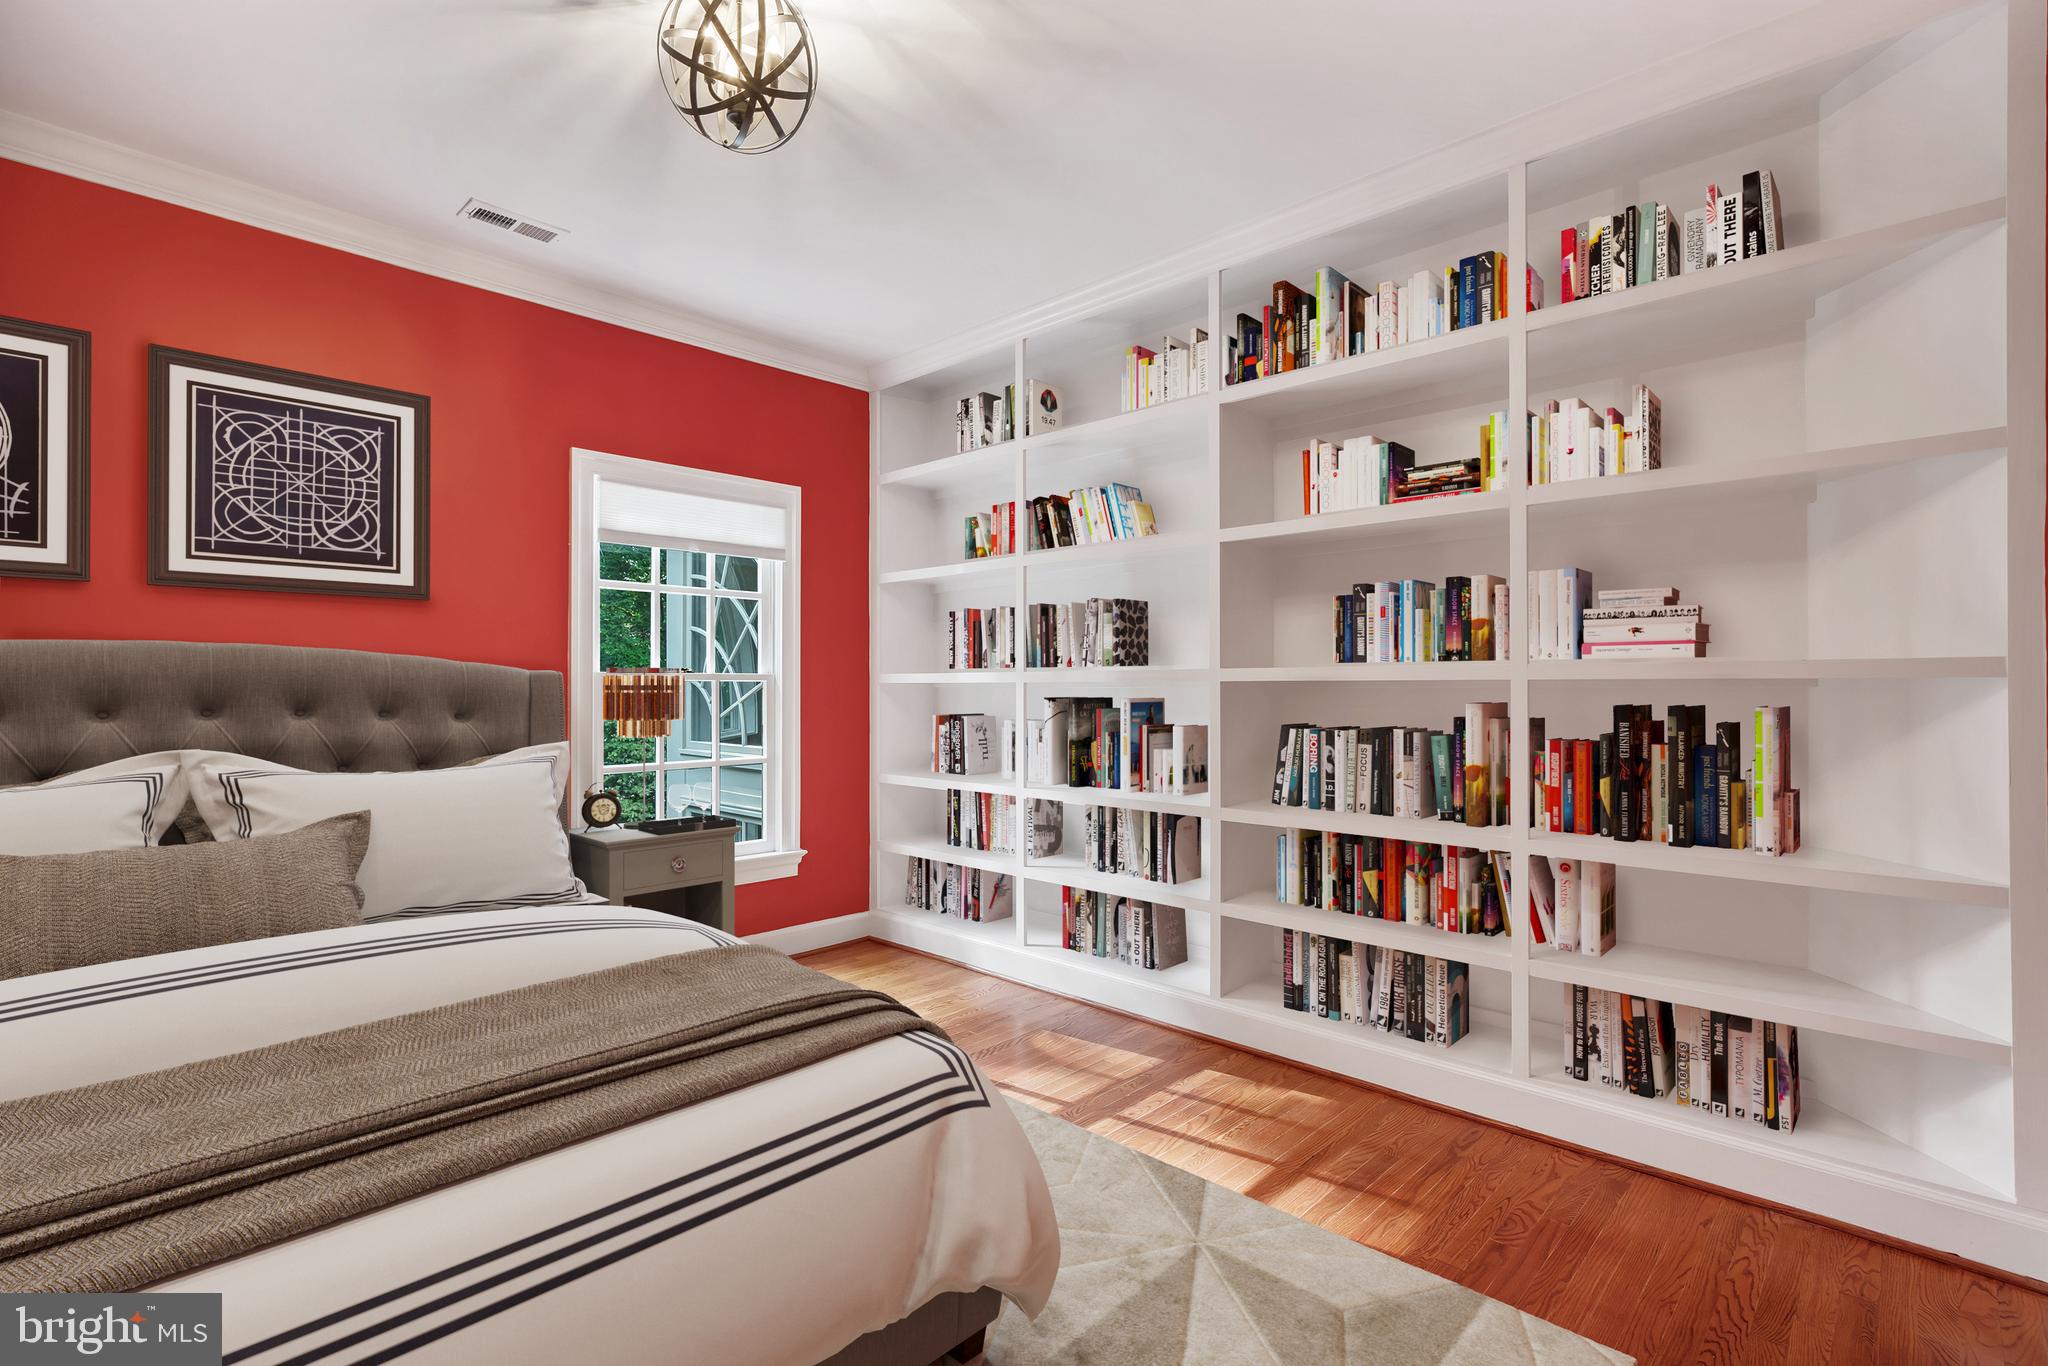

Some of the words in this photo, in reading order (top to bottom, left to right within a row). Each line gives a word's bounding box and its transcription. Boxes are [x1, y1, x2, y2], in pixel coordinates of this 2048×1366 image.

[1657, 210, 1665, 227] LEE
[1724, 198, 1736, 239] THERE
[1763, 200, 1771, 211] THE
[1765, 212, 1774, 233] WHERE
[1687, 220, 1695, 262] GWENDRY
[1696, 218, 1704, 269] RAMADHANY
[1619, 722, 1630, 758] BANISHED
[1701, 756, 1712, 767] just
[1703, 768, 1714, 789] friends
[1719, 775, 1729, 806] GRAVITY'S
[1719, 807, 1729, 835] RAINBOW
[1560, 878, 1572, 907] Sixties
[1394, 957, 1404, 989] HORSE
[1319, 992, 1326, 1002] ON
[1380, 991, 1388, 1010] 1984
[1394, 992, 1404, 1013] WAR
[1601, 991, 1609, 1021] Kingdom
[1648, 1017, 1657, 1044] division
[1701, 1016, 1710, 1061] HUMILITY
[1714, 1023, 1723, 1041] Book
[1650, 1045, 1660, 1056] joy
[1691, 1043, 1699, 1061] Dry
[1714, 1042, 1723, 1056] The
[1735, 1036, 1744, 1086] TYPOMANIA
[1678, 1042, 1687, 1098] FABLES
[1753, 1058, 1762, 1086] Coetzee
